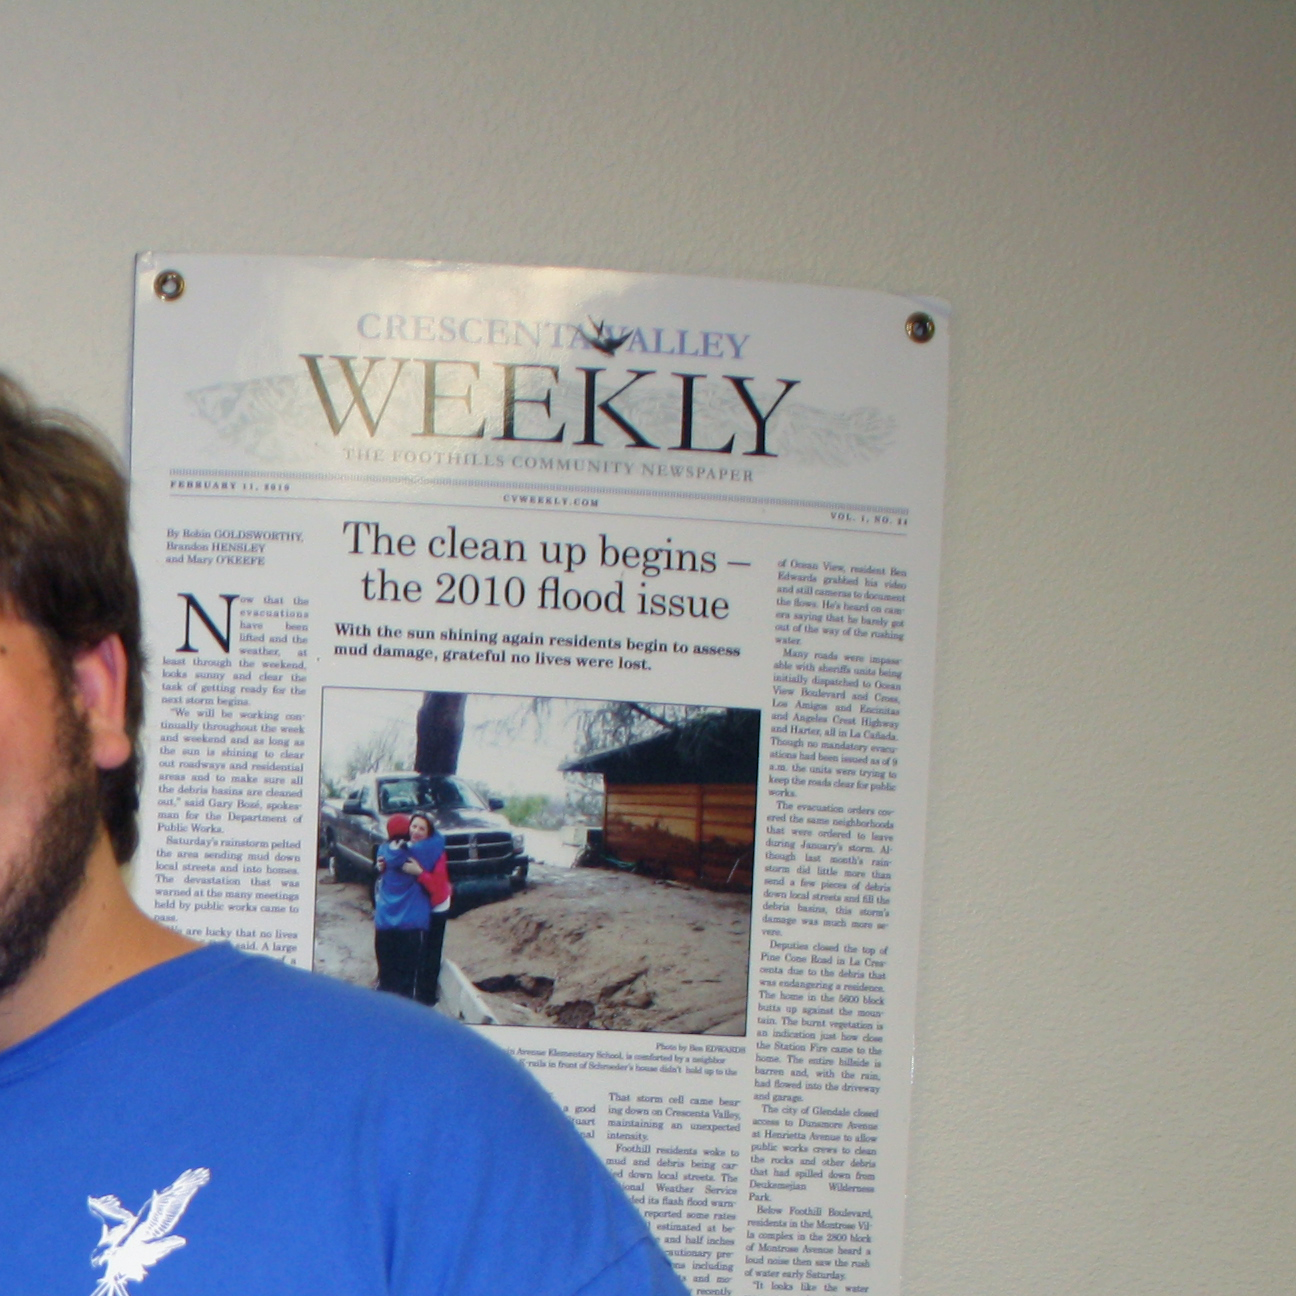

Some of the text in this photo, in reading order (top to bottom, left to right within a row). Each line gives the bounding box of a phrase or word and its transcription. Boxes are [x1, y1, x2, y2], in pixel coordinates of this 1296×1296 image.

[356, 312, 750, 359] CRESCENTA VALLEY
[299, 353, 801, 457] WEEKLY
[342, 447, 754, 483] THE FOOTHILLS COMMUNITY NEWSPAPER
[170, 480, 290, 492] FEBRUARY 11, 2010
[503, 494, 599, 507] CVWEEKLY.COM
[830, 512, 855, 522] VOL.
[874, 515, 892, 524] NO.
[167, 528, 304, 542] By Robin GOLDSWORTHY,
[166, 541, 266, 553] Brandon HENSLEY
[342, 521, 718, 577] The clean up begins
[165, 555, 184, 563] and
[187, 554, 214, 565] Mary
[362, 569, 729, 619] the 2010 flood issue
[334, 623, 741, 656] With the sun shining again residents begin to assess
[334, 643, 651, 671] mud damage, grateful no lives were lost.
[157, 822, 224, 834] Public Works.
[166, 835, 301, 850] Saturday's rainstorm pelted
[656, 1042, 677, 1051] Photo
[608, 1092, 714, 1106] That storm cell came
[761, 1103, 779, 1114] The
[781, 1105, 798, 1116] city
[812, 1106, 851, 1117] Glendale
[853, 1108, 879, 1118] closed
[615, 1143, 651, 1154] Foothill
[656, 1146, 698, 1156] residents
